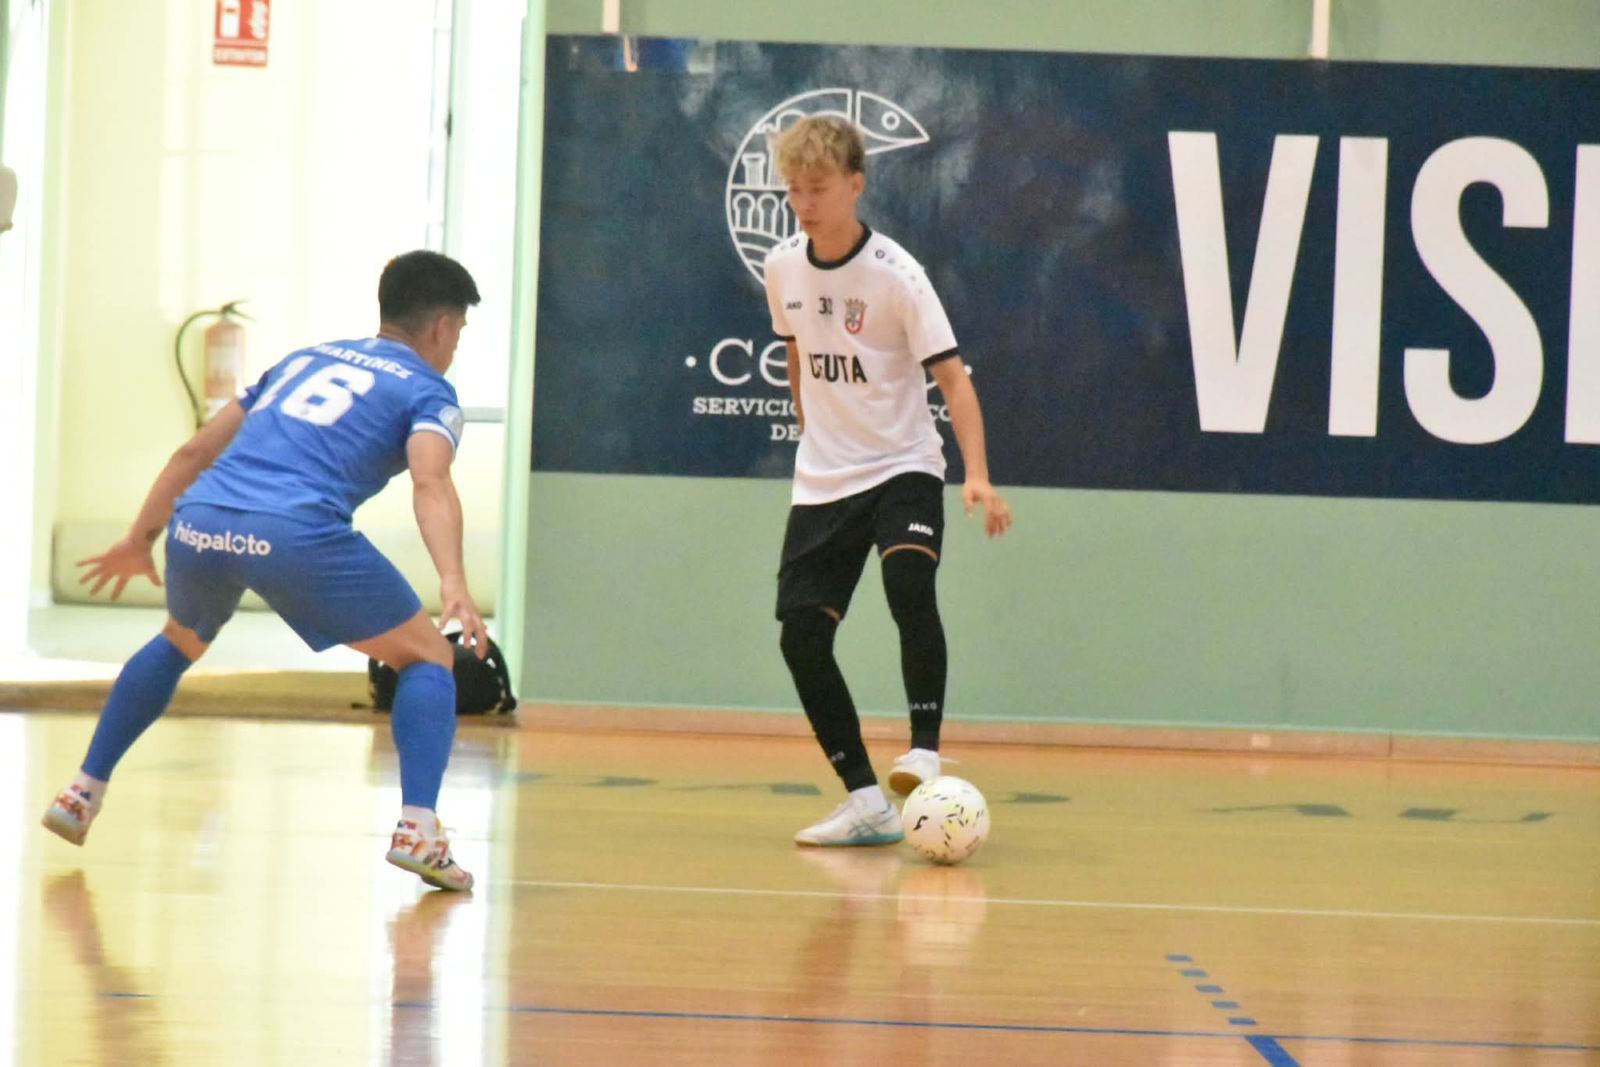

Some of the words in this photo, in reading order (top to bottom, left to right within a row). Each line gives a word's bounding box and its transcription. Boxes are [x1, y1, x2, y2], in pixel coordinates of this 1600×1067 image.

[248, 355, 375, 427] 16
[174, 521, 271, 555] hispaloto
[908, 522, 934, 536] JAKO
